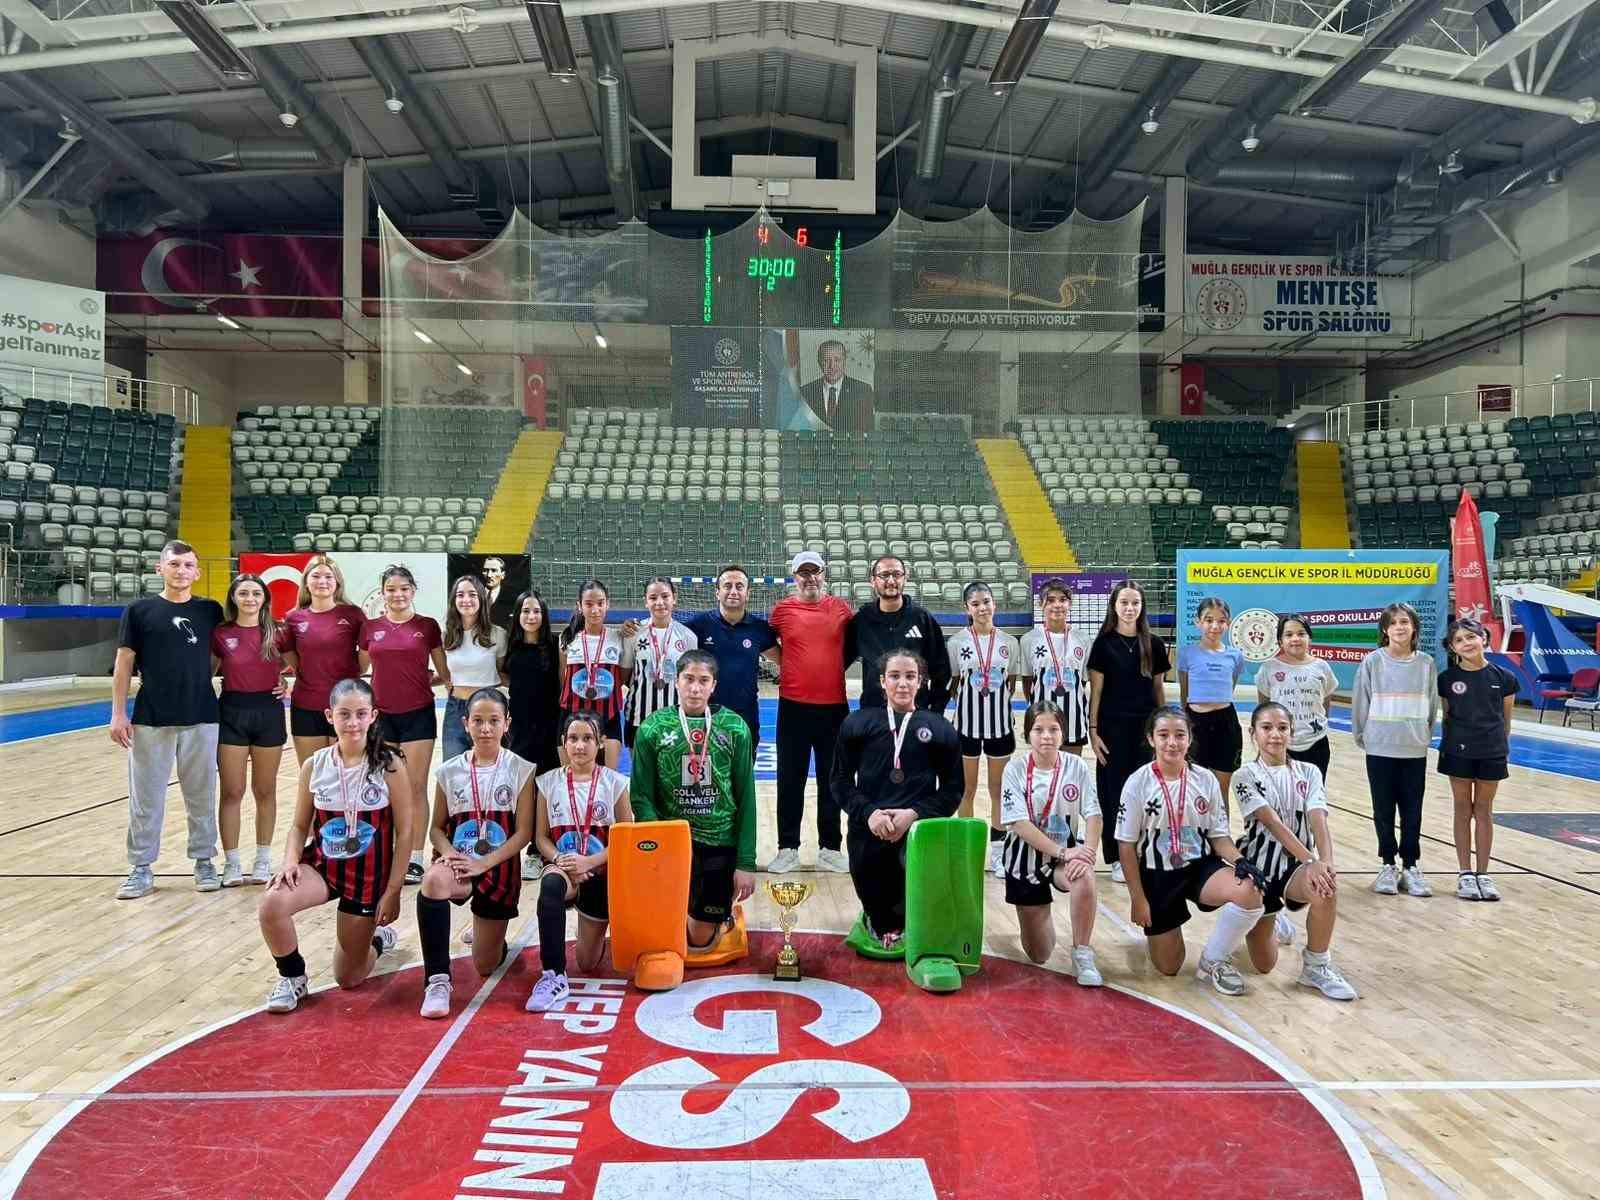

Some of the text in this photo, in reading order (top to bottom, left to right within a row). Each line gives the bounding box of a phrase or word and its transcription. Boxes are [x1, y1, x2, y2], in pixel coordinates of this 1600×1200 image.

[797, 228, 807, 246] 6
[747, 258, 796, 276] 30:00
[1191, 260, 1228, 275] MUĞLA
[1231, 261, 1276, 278] GENÇLİK
[1279, 264, 1294, 275] VE
[1296, 264, 1322, 276] SPOR
[1276, 280, 1378, 311] MENTEŞE
[934, 313, 988, 325] ADAMLAR
[1263, 311, 1391, 332] SPOR SALONU
[1193, 565, 1431, 580] MUĞLA GENÇLİK VE SPOR İL MÜDÜRLÜĞÜ
[1310, 611, 1382, 624] SPOR OKULLAR
[1336, 649, 1369, 661] TÖREN
[679, 796, 715, 805] BANKER
[452, 978, 628, 1200] HEP YANIN
[592, 973, 938, 1200] GS
